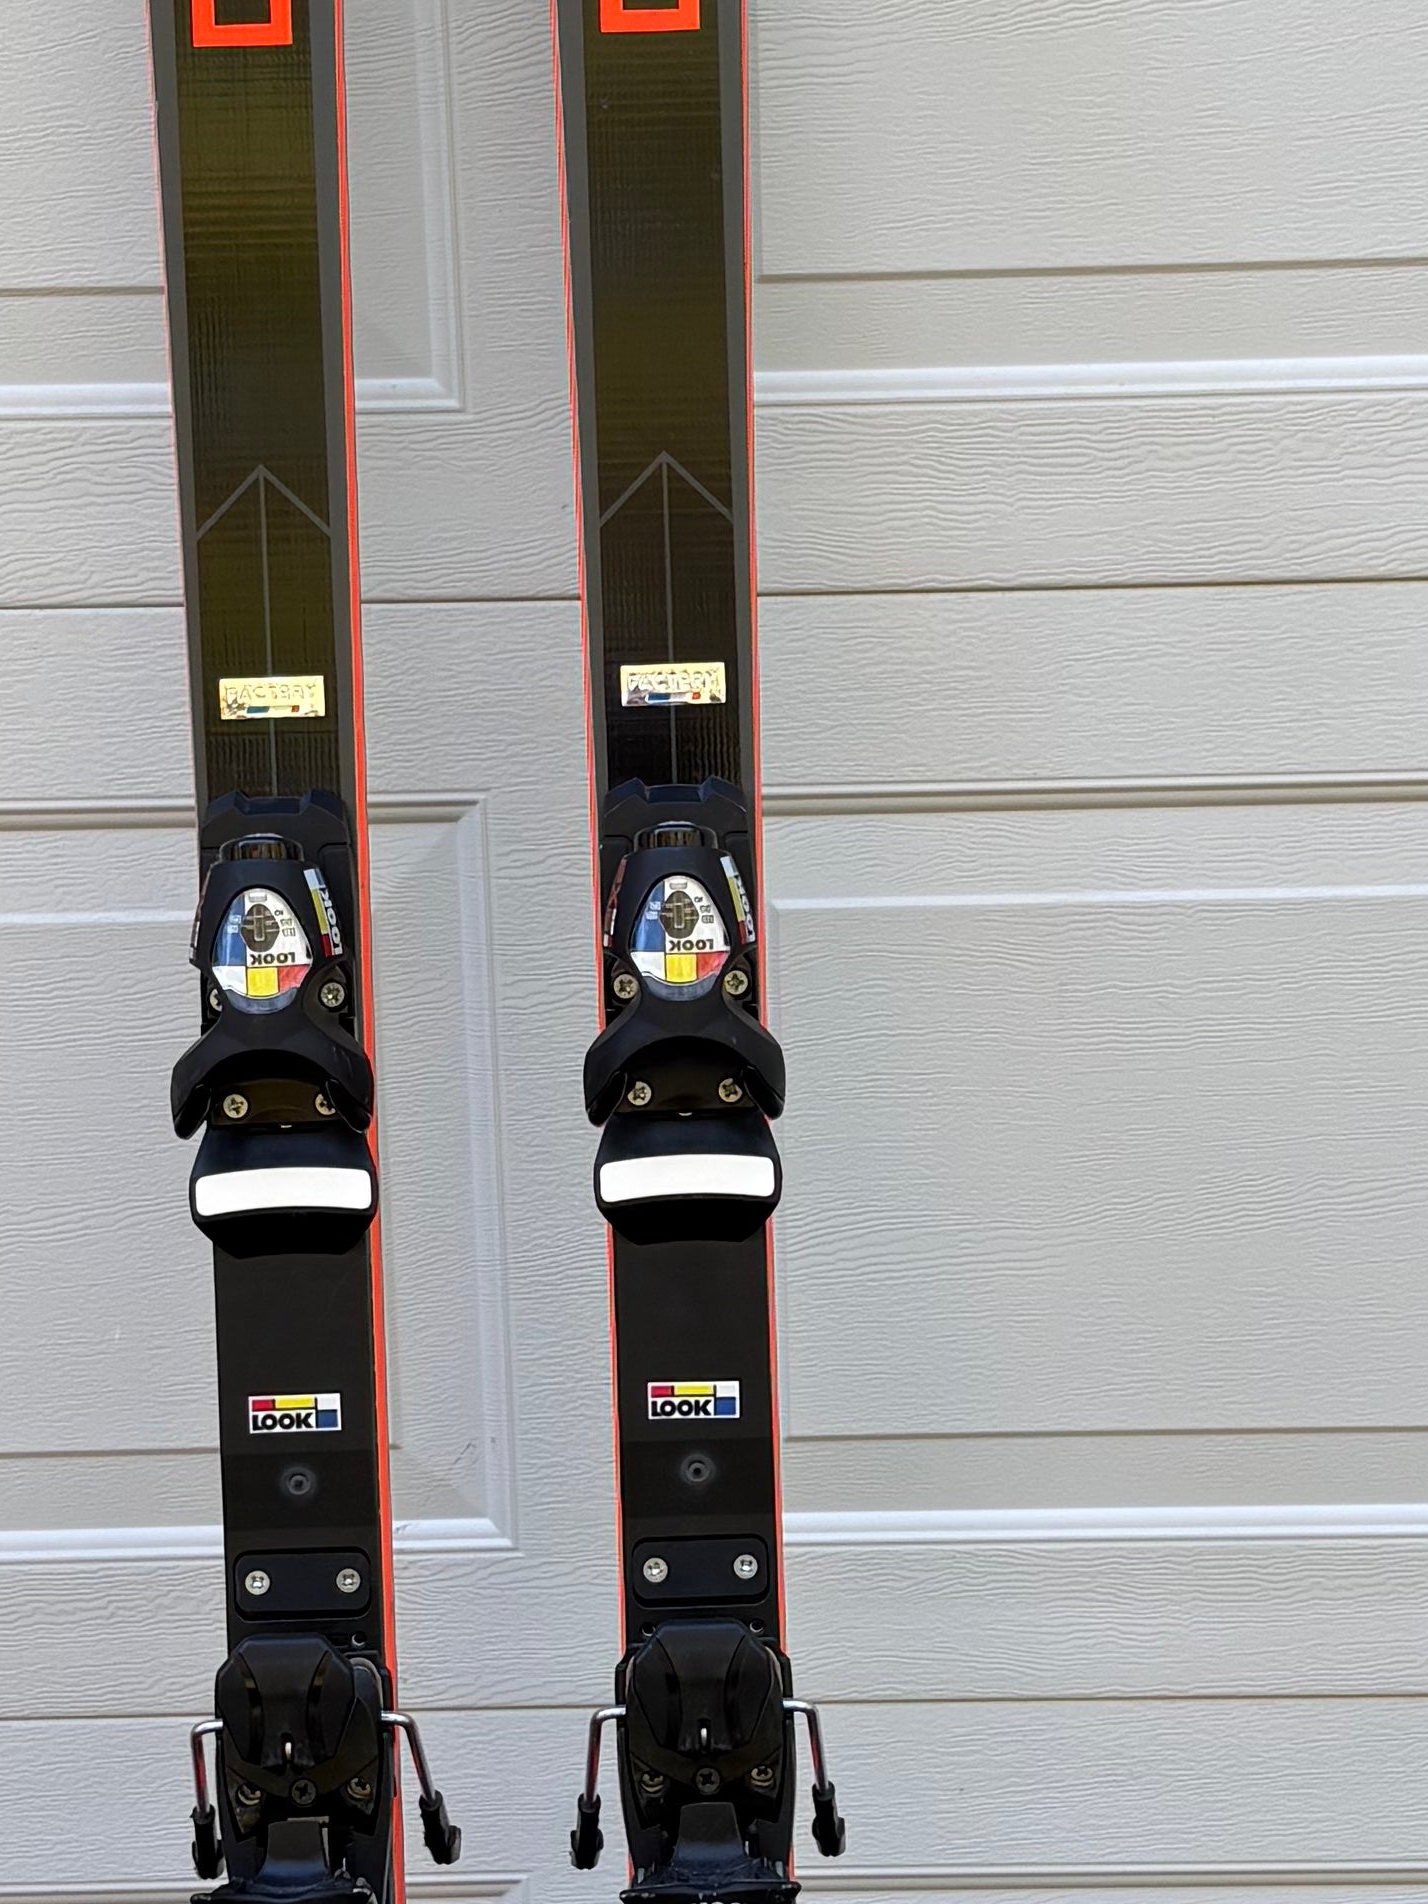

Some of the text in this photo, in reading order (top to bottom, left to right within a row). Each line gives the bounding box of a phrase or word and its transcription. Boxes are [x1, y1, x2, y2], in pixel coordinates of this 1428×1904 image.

[319, 888, 344, 955] LOOK
[668, 938, 714, 951] LOOK
[250, 952, 296, 966] LOOK
[651, 1399, 712, 1417] LOOK
[252, 1412, 314, 1431] LOOK
